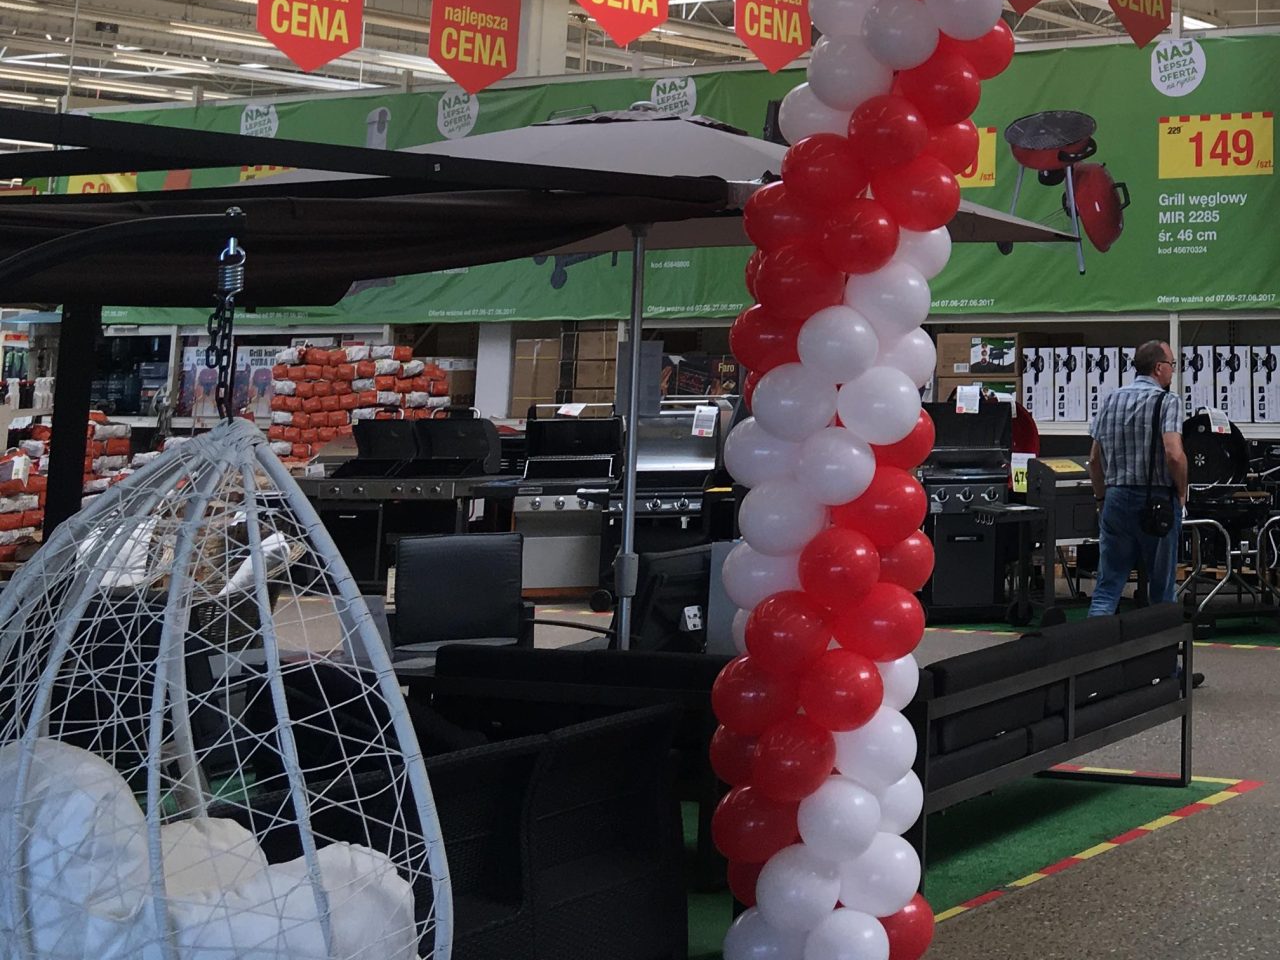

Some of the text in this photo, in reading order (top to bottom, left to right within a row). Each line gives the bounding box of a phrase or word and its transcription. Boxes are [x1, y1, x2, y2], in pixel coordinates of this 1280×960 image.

[444, 6, 508, 31] najlepsza
[744, 1, 803, 46] CENA
[441, 27, 507, 68] CENA
[1156, 41, 1193, 64] NAJ
[1158, 57, 1195, 73] LEPSZA
[1160, 67, 1198, 83] OFERTA
[656, 77, 688, 96] NAJ
[442, 93, 470, 110] NAJ
[656, 91, 687, 105] LEPSZA
[245, 104, 270, 123] NAJ
[443, 105, 470, 119] LEPSZA
[444, 114, 471, 128] OFERTA
[1188, 129, 1254, 167] 149
[1158, 192, 1247, 207] Grill węglowy
[1159, 210, 1220, 224] MIR 2285
[1158, 229, 1217, 242] śr. 46 cm
[1157, 295, 1179, 303] Oferta
[1181, 295, 1203, 303] ważna
[718, 362, 735, 373] Faro
[1014, 471, 1028, 485] 47
